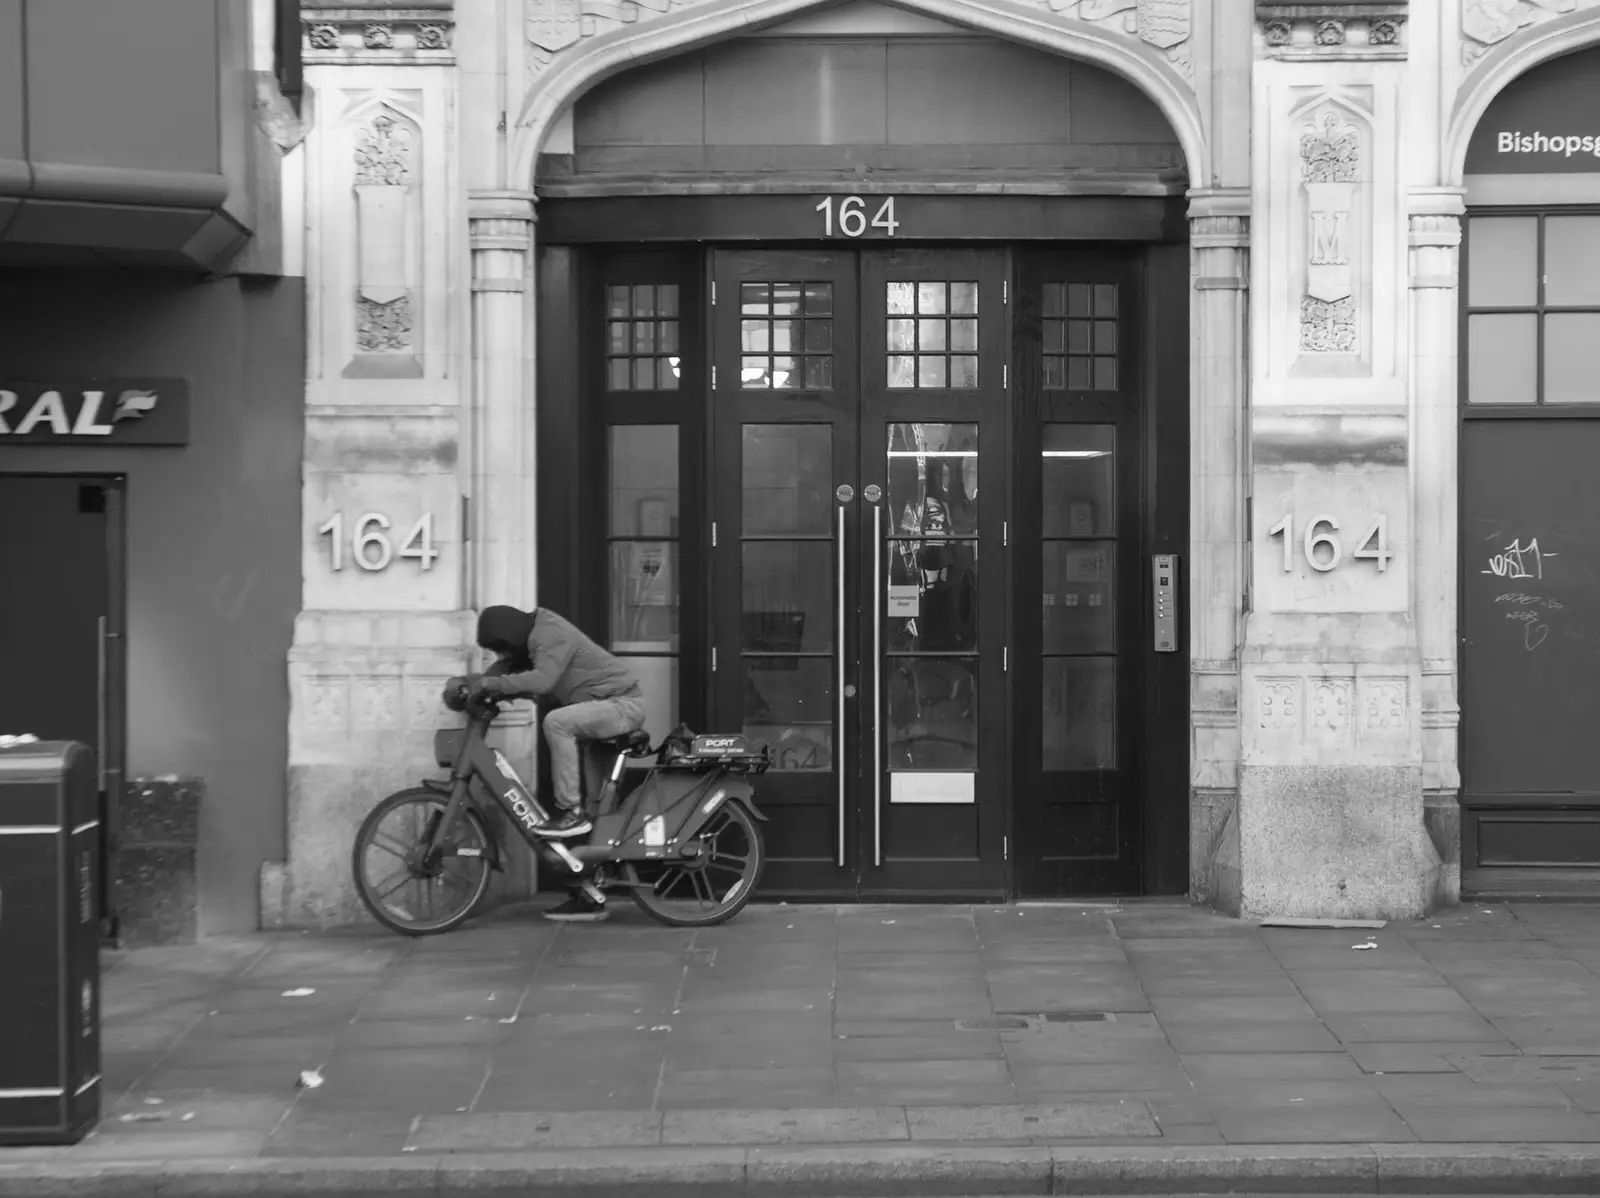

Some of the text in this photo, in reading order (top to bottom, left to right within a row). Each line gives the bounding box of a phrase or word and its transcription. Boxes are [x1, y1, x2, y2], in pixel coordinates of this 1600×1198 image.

[816, 196, 900, 237] 164
[1310, 210, 1350, 265] M
[319, 512, 439, 572] 164
[1269, 513, 1394, 572] 164
[705, 738, 737, 748] PORT
[503, 787, 546, 829] POR
